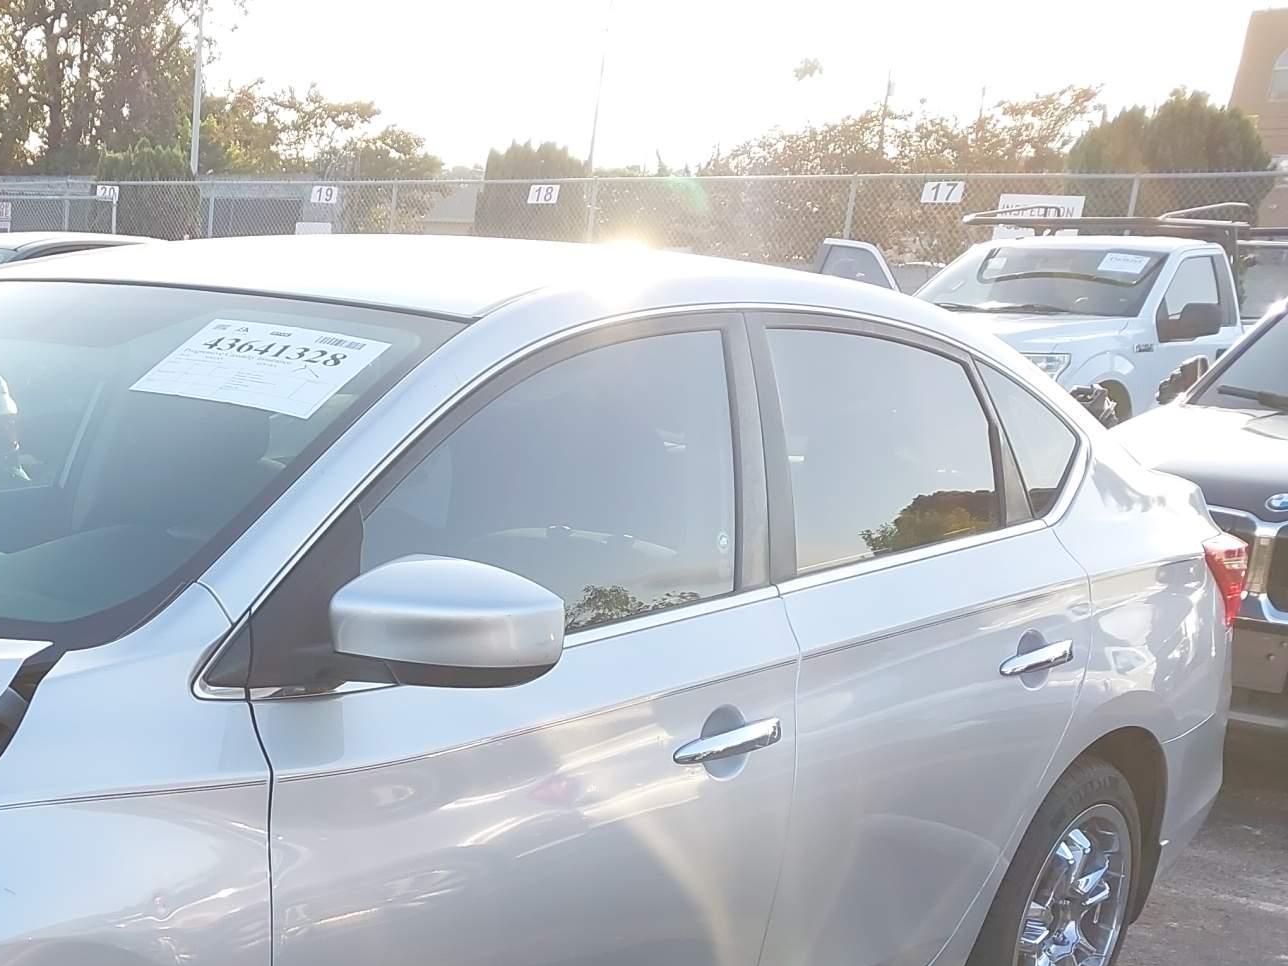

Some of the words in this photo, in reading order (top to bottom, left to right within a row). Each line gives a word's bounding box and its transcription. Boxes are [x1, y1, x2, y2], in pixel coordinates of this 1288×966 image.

[100, 186, 117, 199] 20
[315, 187, 334, 202] 19
[534, 187, 554, 202] 18
[930, 183, 959, 201] 17
[202, 336, 349, 367] 43641328
